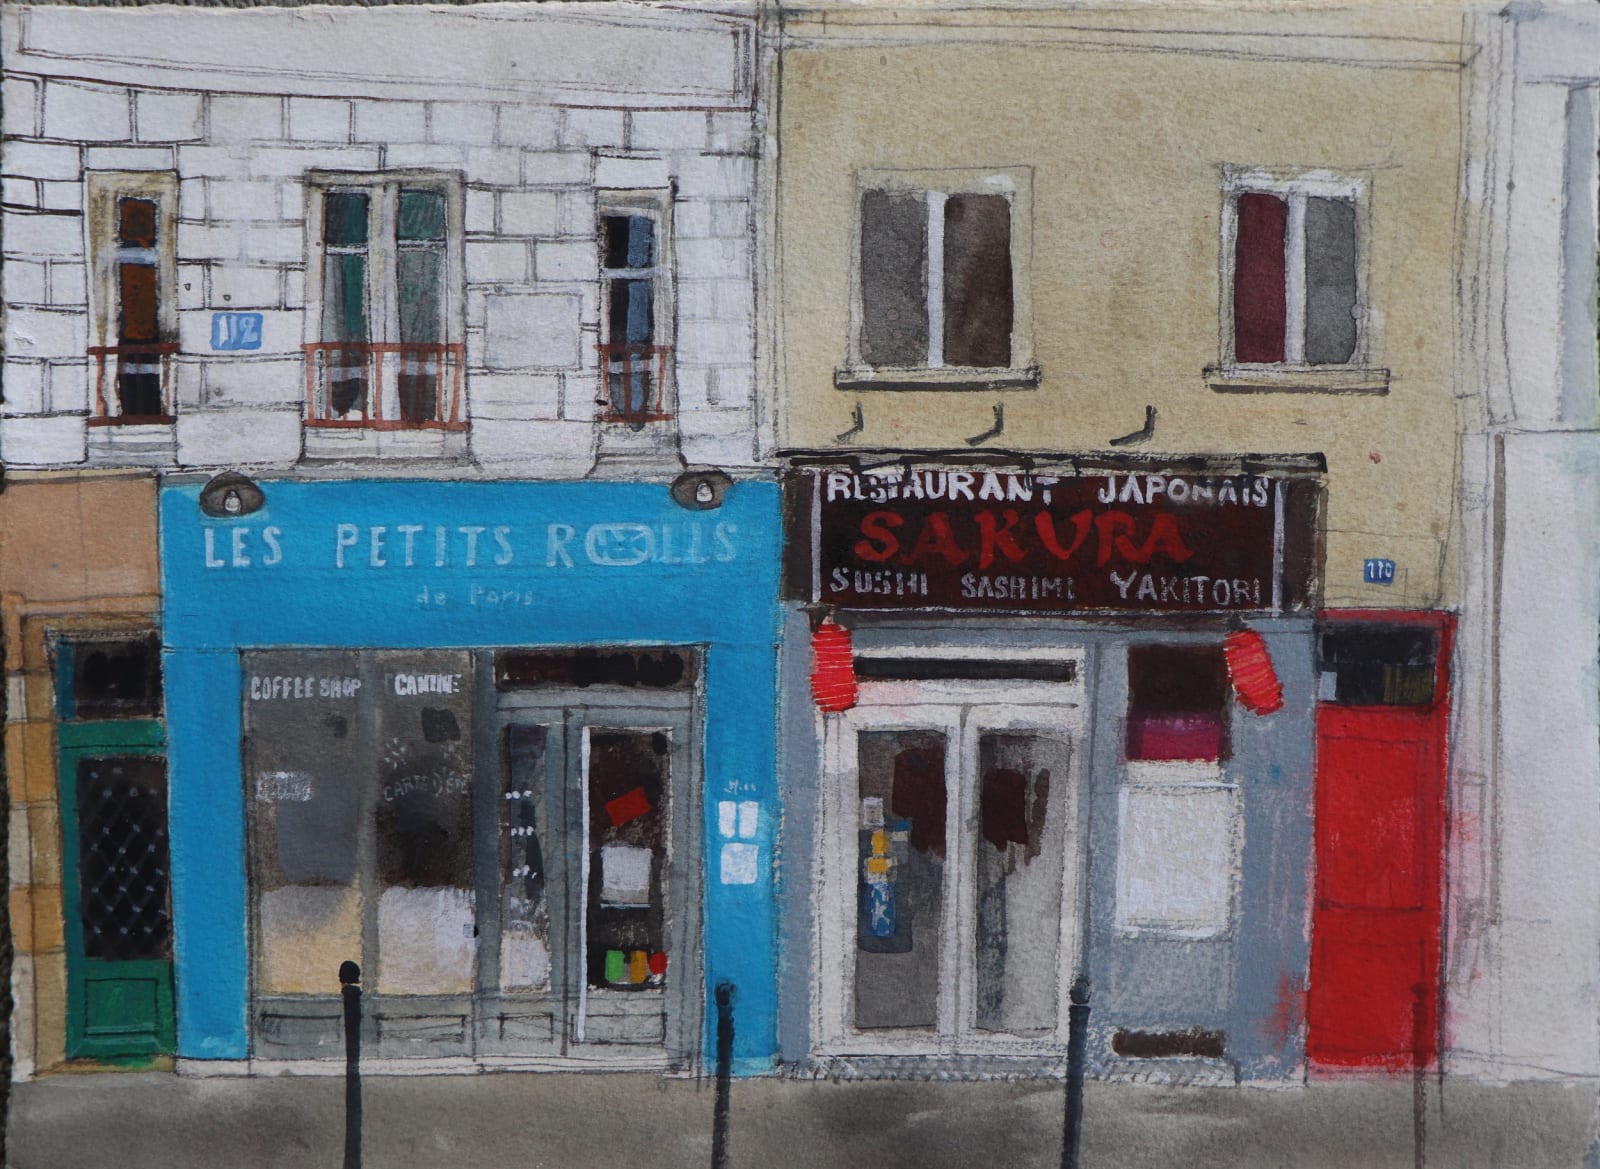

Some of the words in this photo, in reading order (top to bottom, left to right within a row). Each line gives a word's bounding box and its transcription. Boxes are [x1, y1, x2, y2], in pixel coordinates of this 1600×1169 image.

[216, 315, 258, 346] 112
[1098, 474, 1268, 507] JAPONAIS
[204, 527, 283, 568] LES
[335, 524, 514, 568] PETITS
[1367, 560, 1392, 579] 110
[416, 584, 447, 606] de
[468, 584, 535, 606] Paris
[830, 567, 929, 596] SUSHI
[961, 571, 1076, 600] SASHIMI
[1110, 570, 1261, 606] YAKITORI
[251, 675, 315, 700] COFFEE
[319, 676, 362, 699] SHOP
